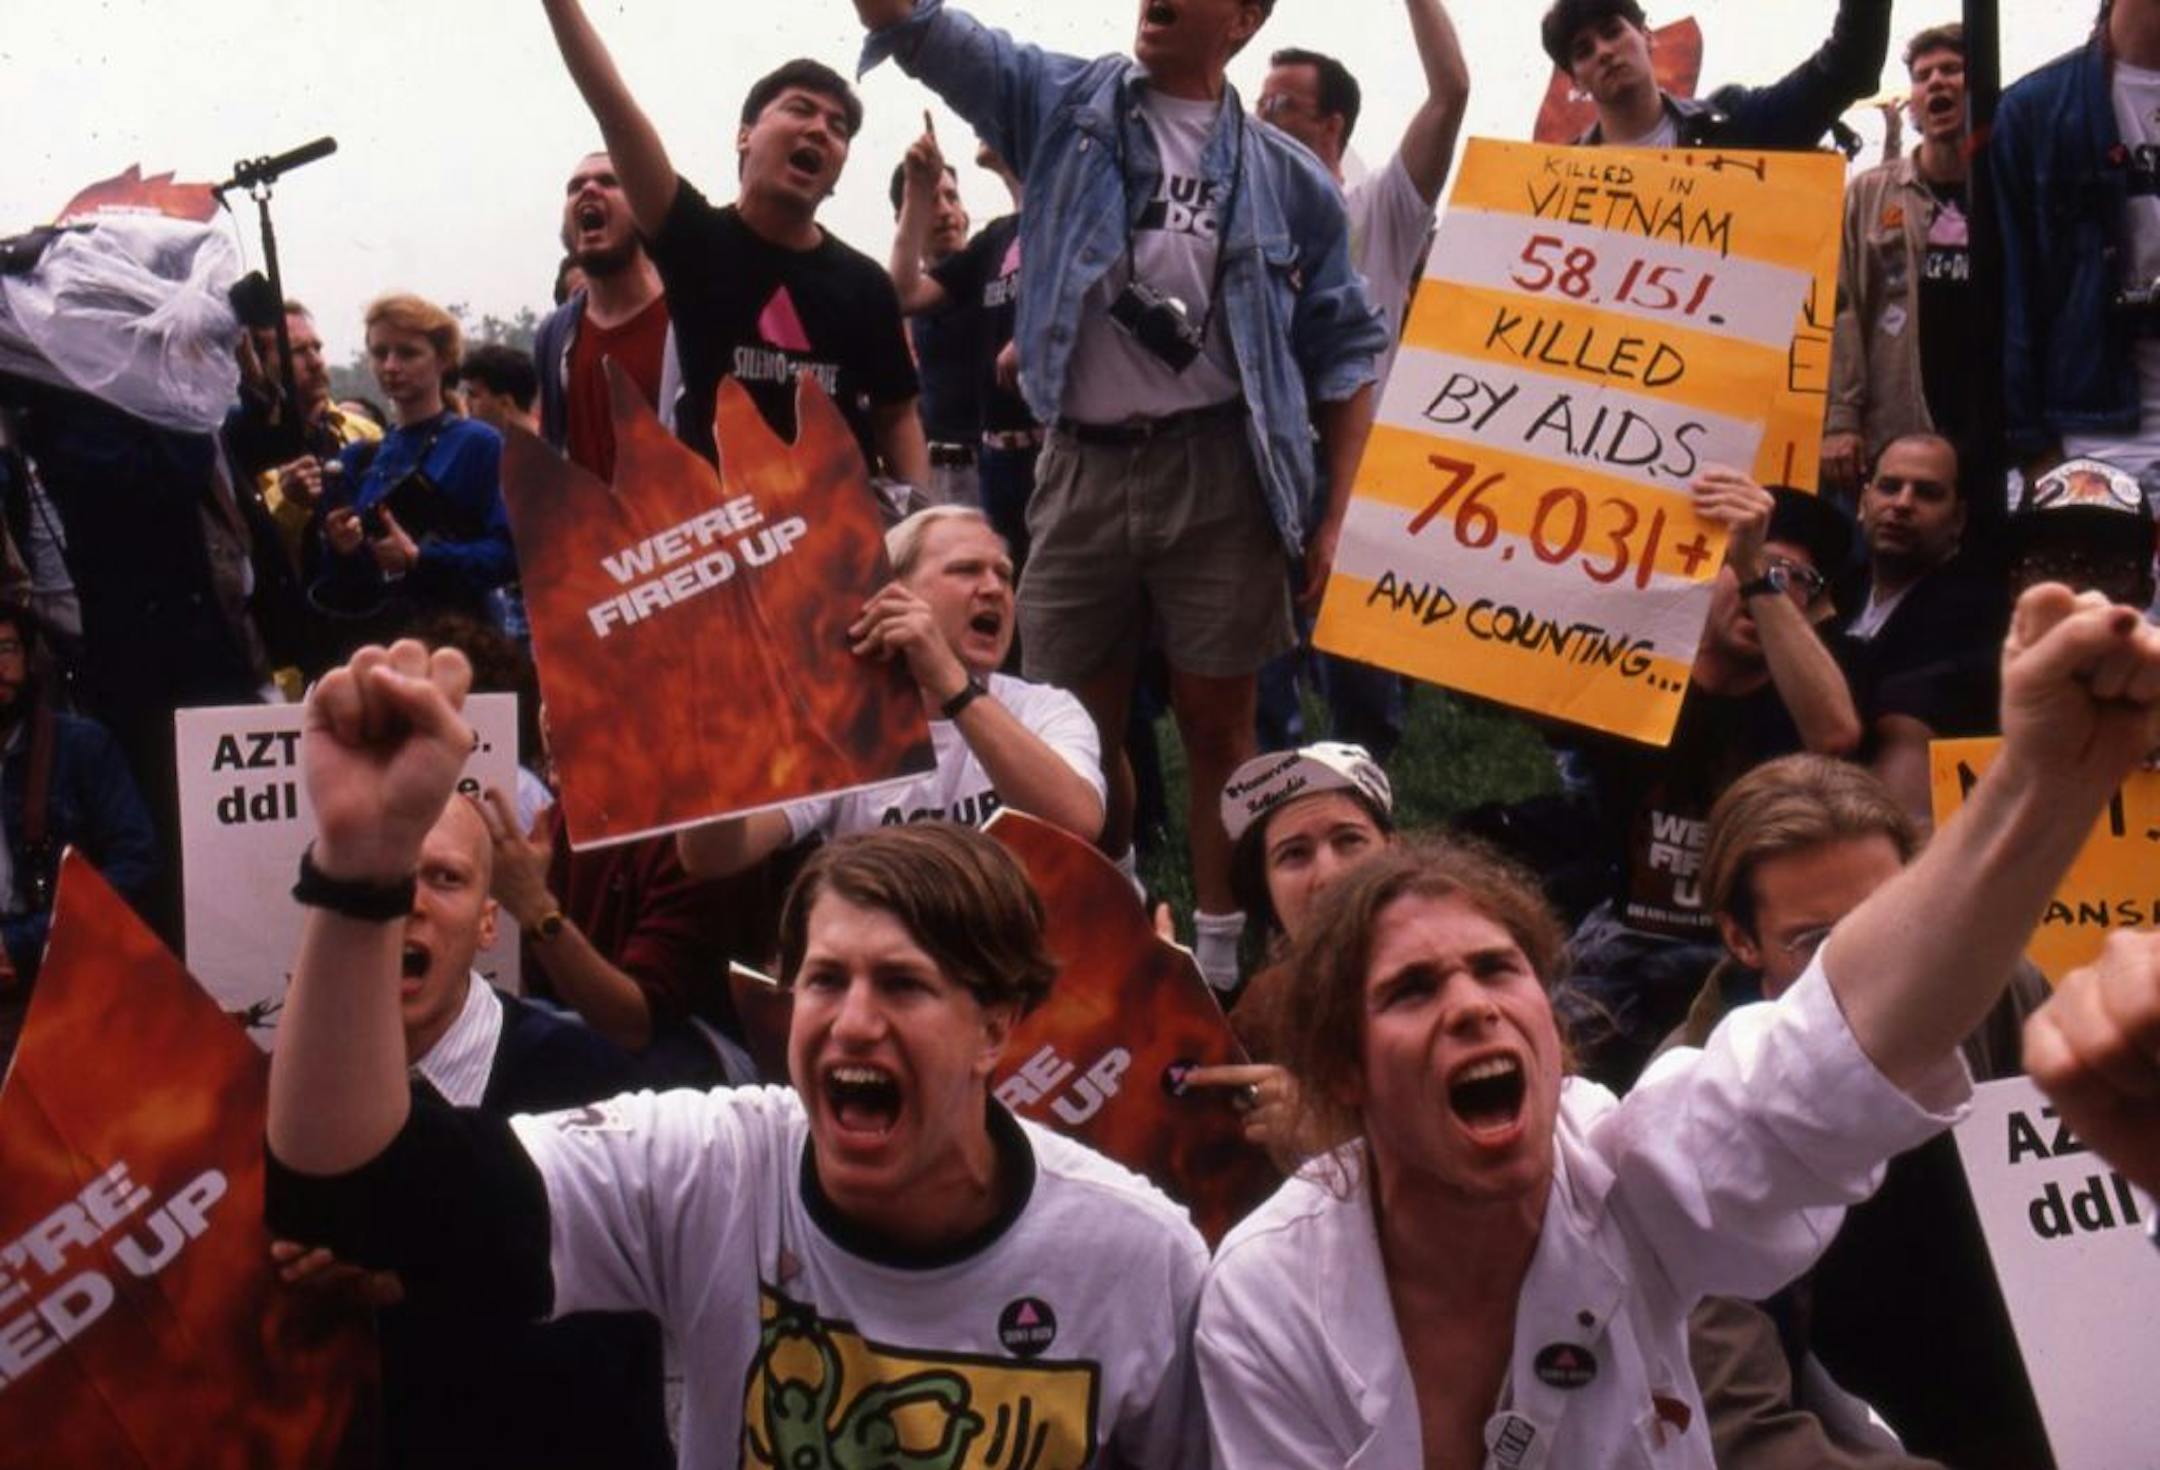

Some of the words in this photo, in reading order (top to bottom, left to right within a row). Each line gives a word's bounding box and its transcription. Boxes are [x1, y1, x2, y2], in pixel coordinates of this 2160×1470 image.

[1543, 157, 1635, 185] KILLED
[1668, 176, 1696, 196] IN
[1526, 181, 1733, 260] VIETNAM
[1485, 306, 1685, 388] KILLED
[1422, 372, 1520, 432] BY
[586, 550, 737, 639] FIRED
[737, 515, 809, 568] UP
[600, 494, 765, 584] WE'RE
[1366, 569, 1457, 626] AND
[211, 729, 302, 772] AZT
[1050, 1047, 1132, 1125] UP
[0, 1270, 115, 1390] ED
[112, 1168, 228, 1277] UP
